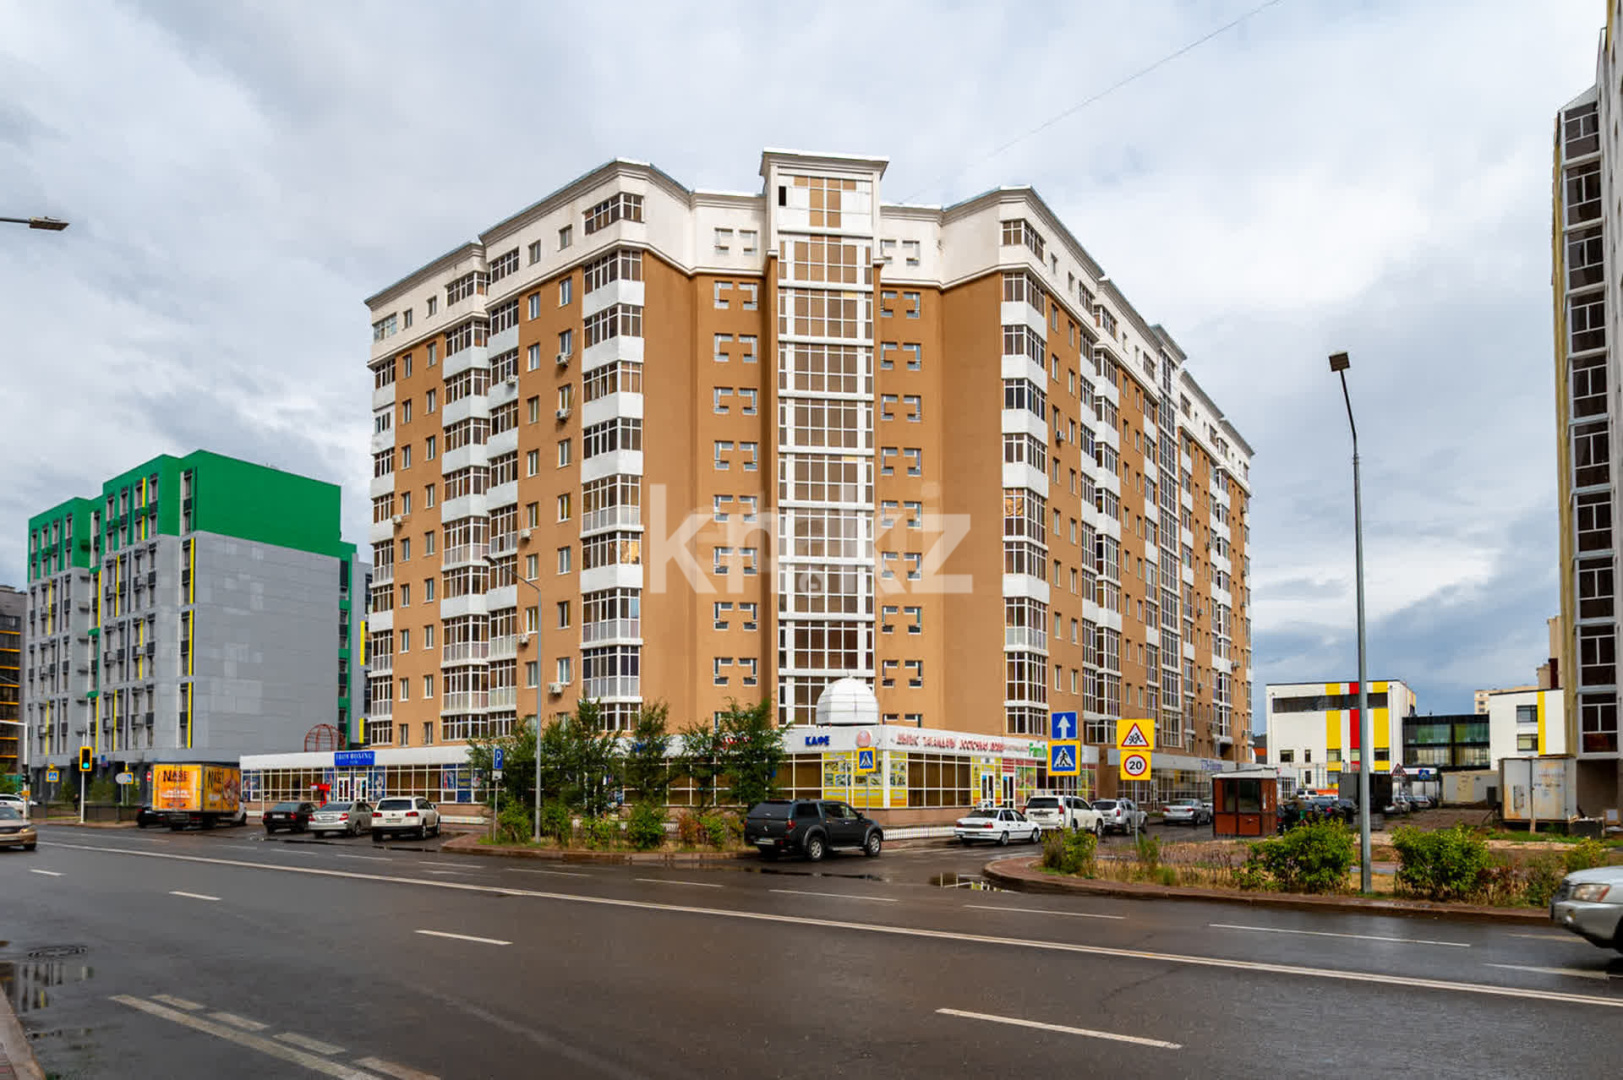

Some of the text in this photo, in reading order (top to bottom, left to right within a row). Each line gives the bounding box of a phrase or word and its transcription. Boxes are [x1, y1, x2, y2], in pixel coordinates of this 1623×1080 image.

[805, 735, 830, 746] КАФЕ
[495, 750, 502, 767] P
[1129, 760, 1143, 770] 20
